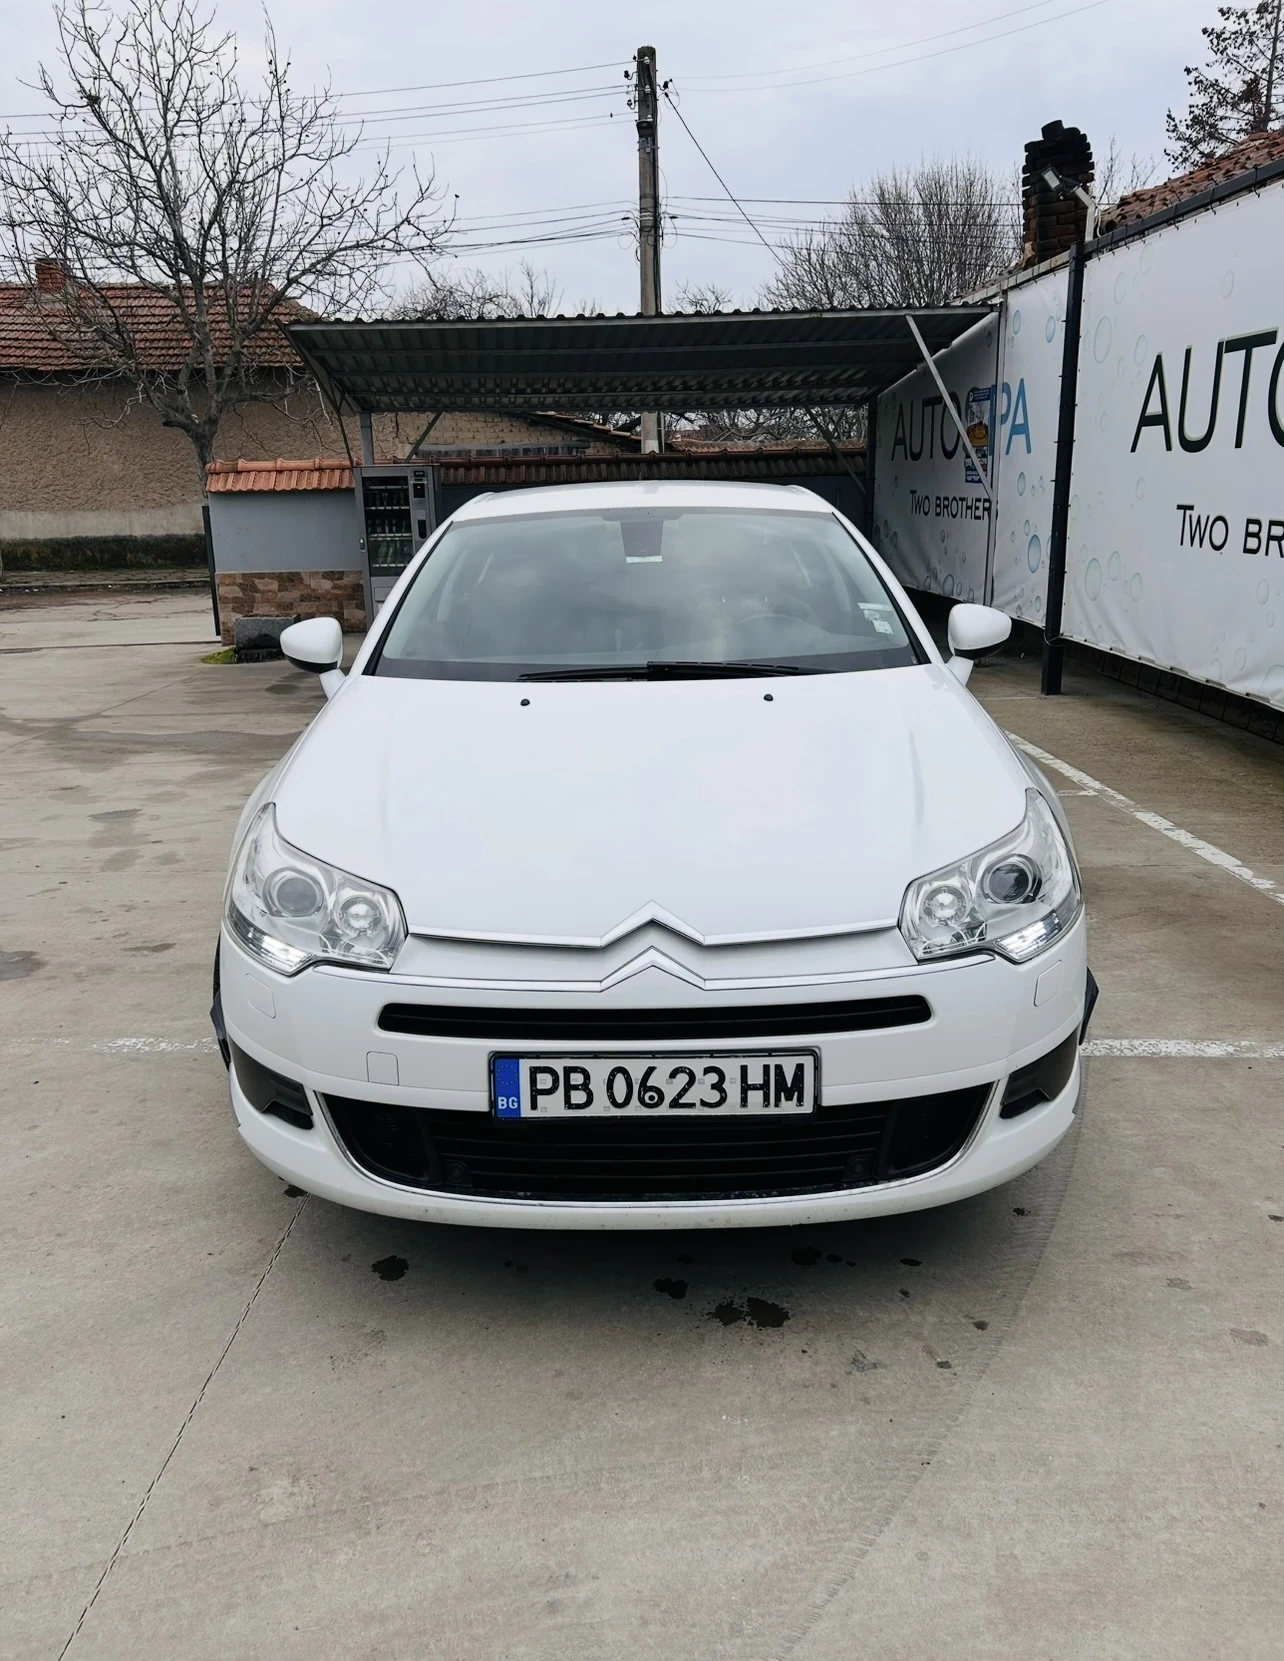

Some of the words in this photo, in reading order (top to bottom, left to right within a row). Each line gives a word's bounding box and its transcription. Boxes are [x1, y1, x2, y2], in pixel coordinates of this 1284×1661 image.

[935, 496, 999, 521] BROTHER
[529, 1065, 594, 1111] PB
[606, 1065, 727, 1110] 0623
[740, 1062, 805, 1109] HM
[497, 1096, 519, 1110] BG
